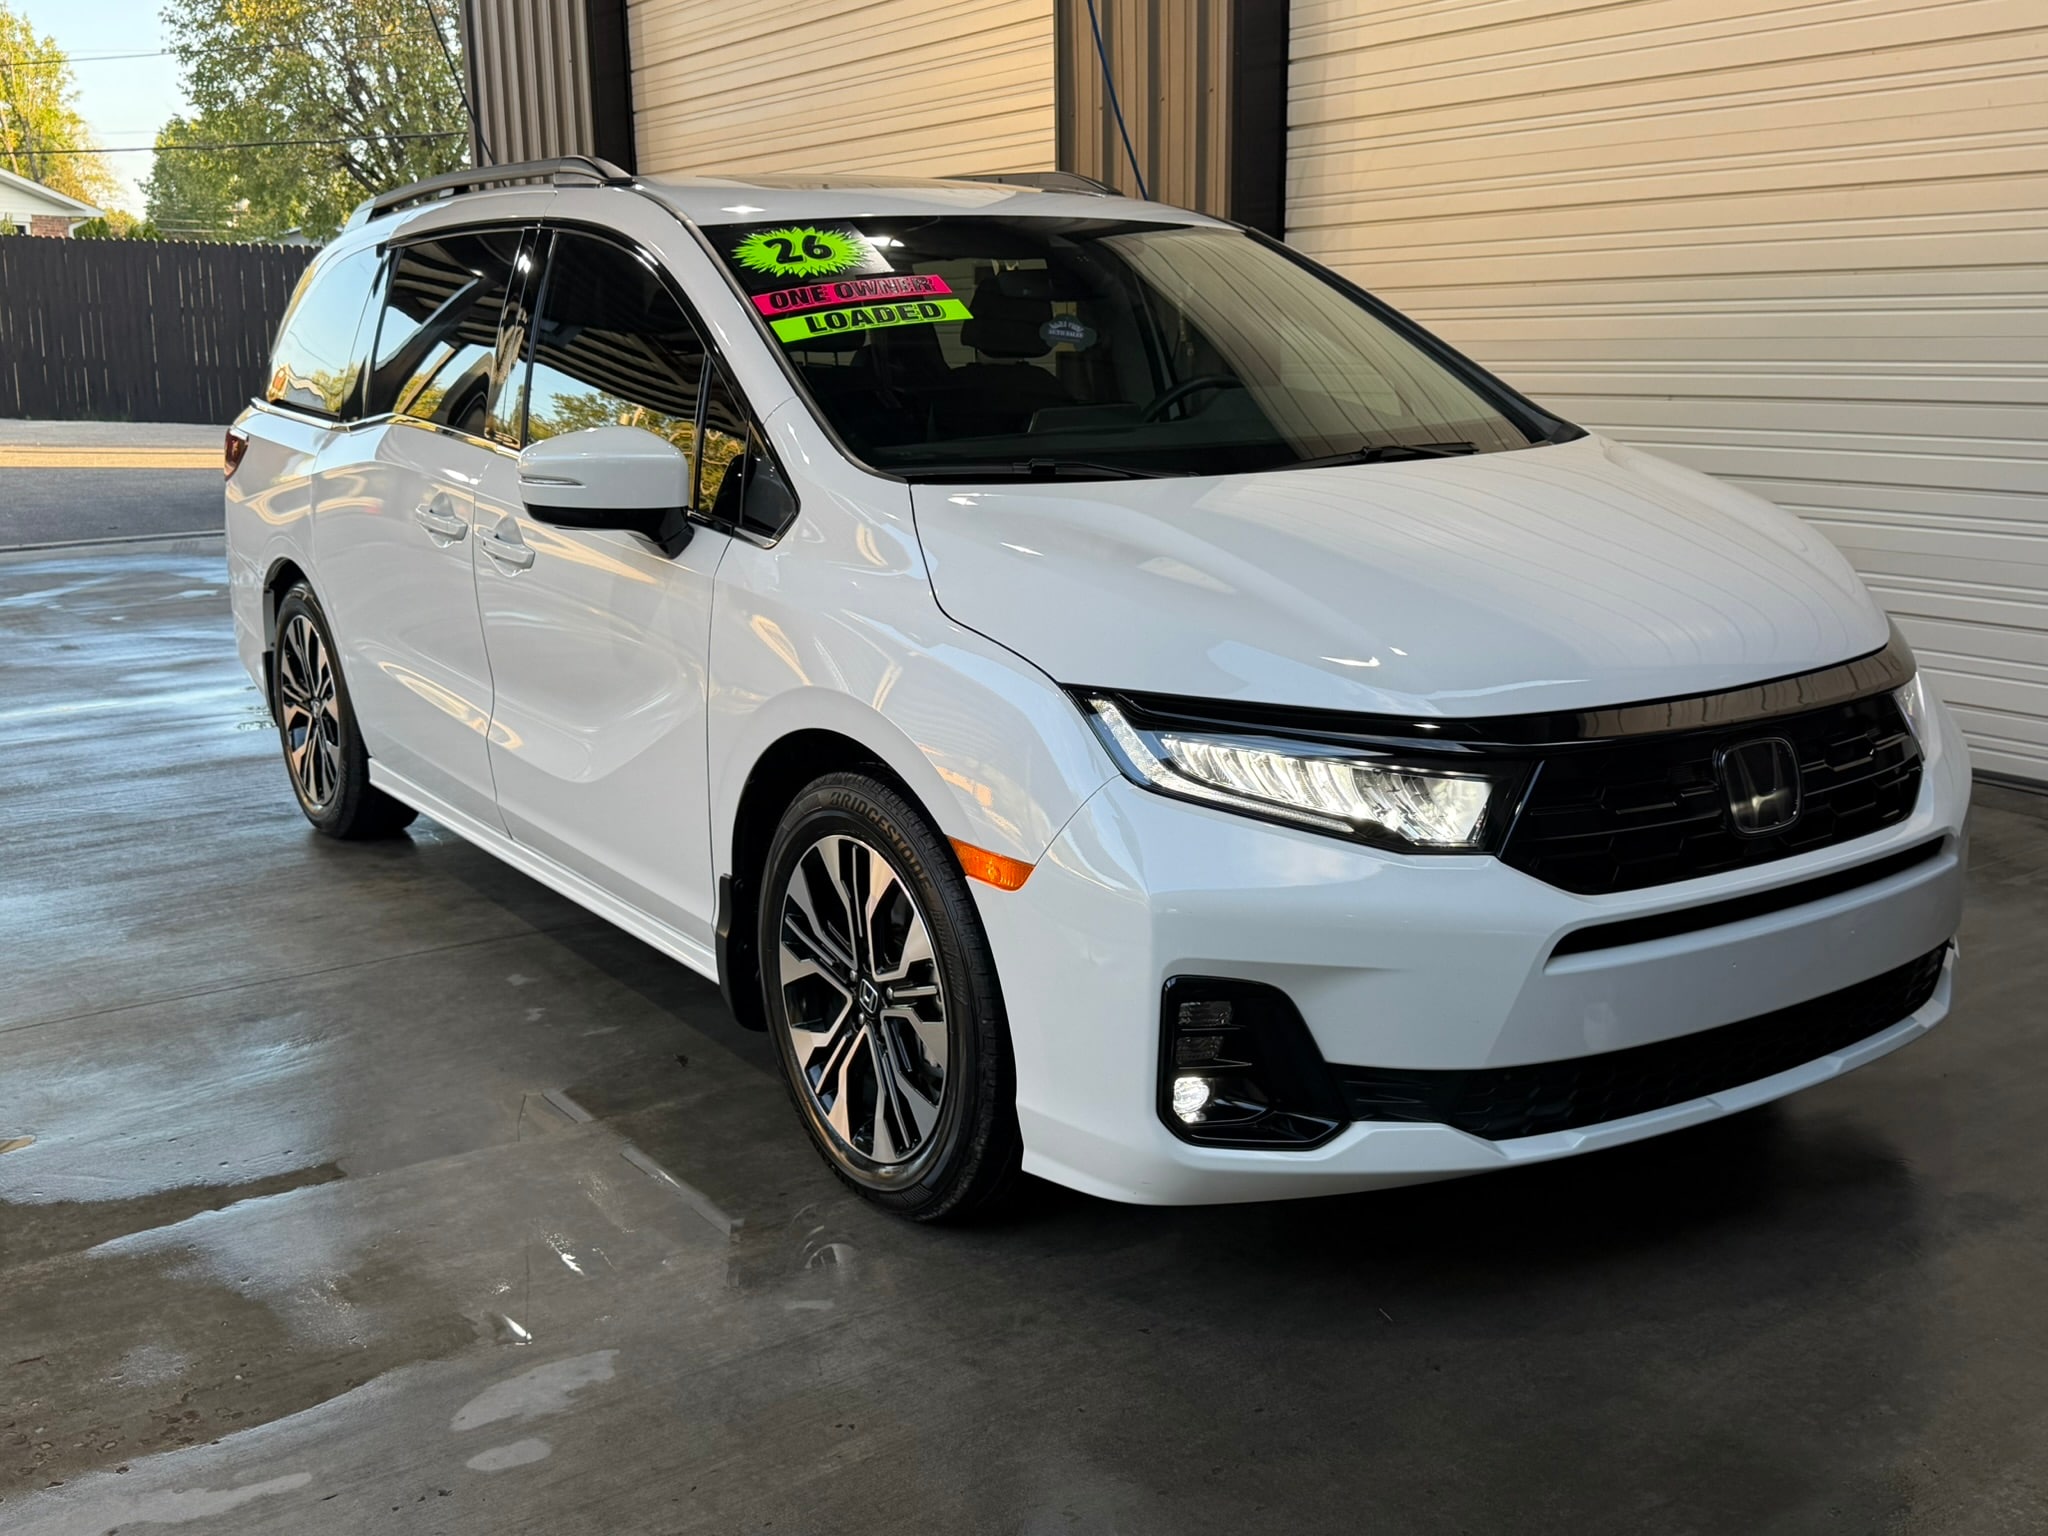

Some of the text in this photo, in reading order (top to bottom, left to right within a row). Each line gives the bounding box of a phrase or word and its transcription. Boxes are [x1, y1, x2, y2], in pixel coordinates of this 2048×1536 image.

[763, 235, 834, 264] 26
[770, 277, 934, 309] ONE OWNER
[805, 302, 945, 333] LOADED
[830, 791, 933, 890] BRIDGESTONE
